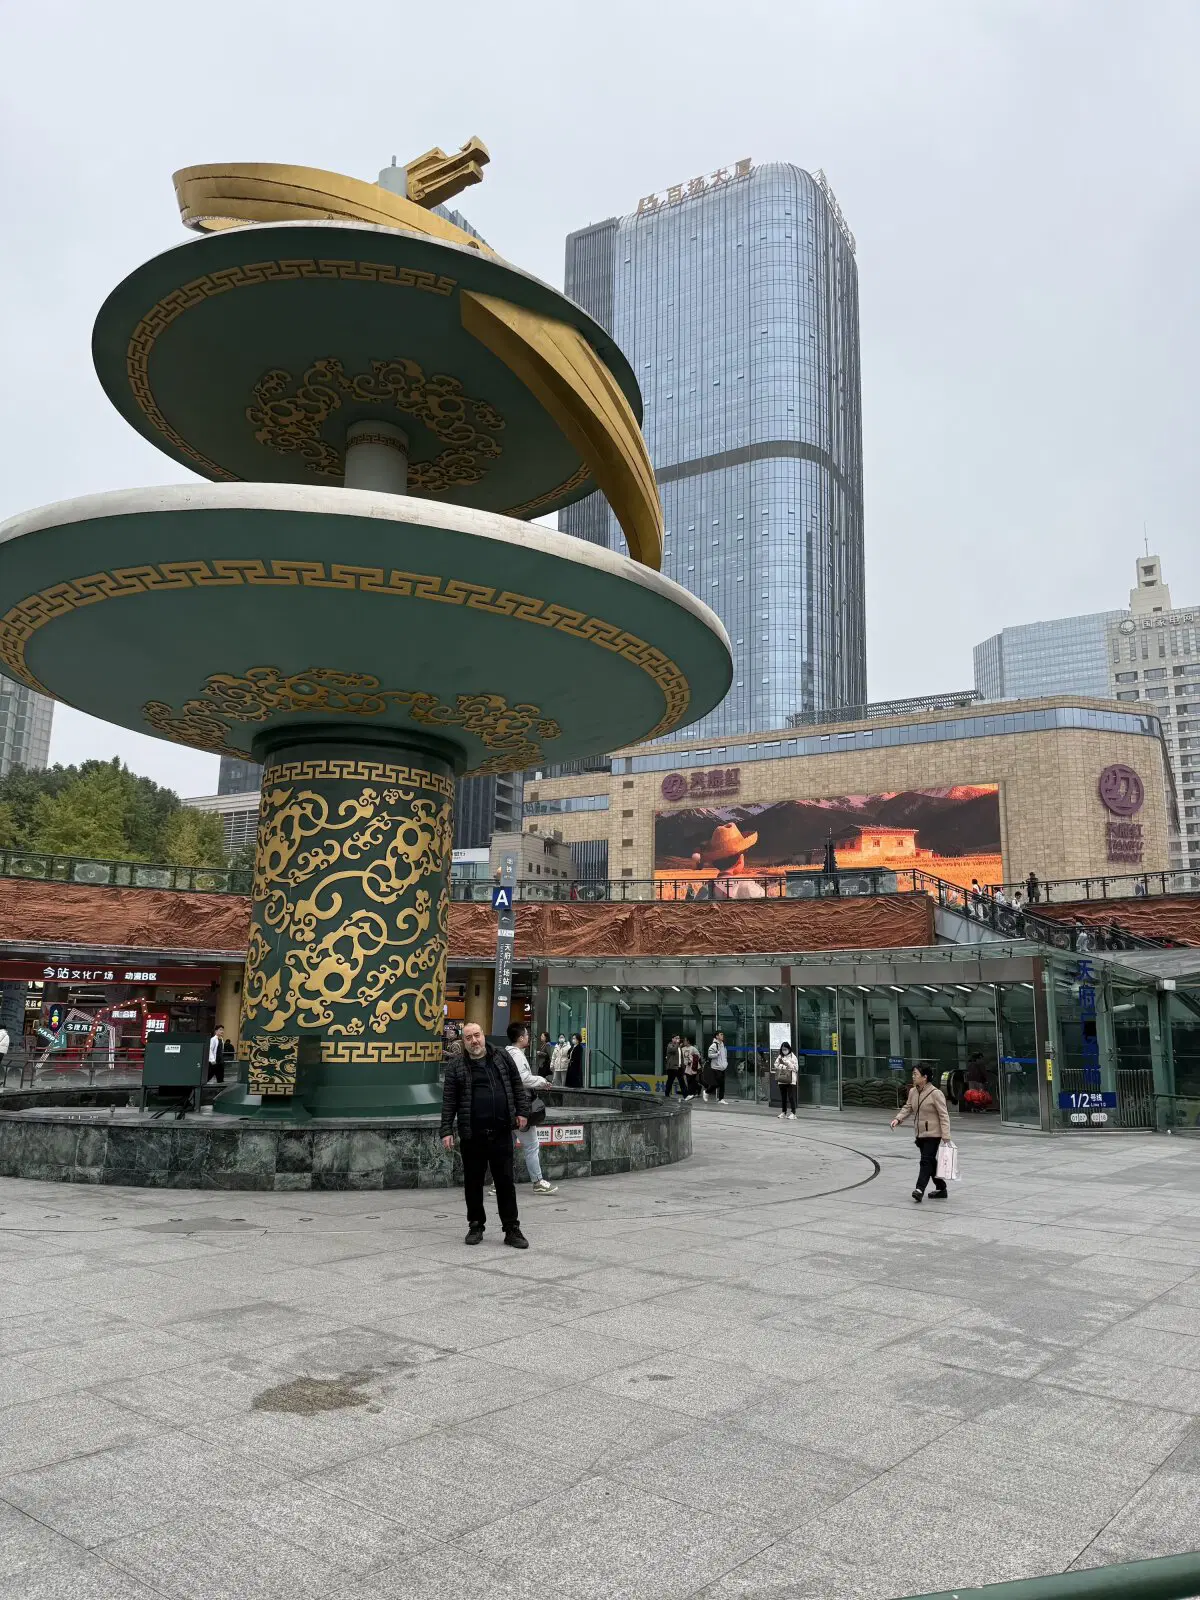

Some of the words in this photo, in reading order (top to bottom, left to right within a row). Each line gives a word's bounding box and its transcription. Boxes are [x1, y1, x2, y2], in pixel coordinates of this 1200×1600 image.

[1142, 613, 1194, 630] 国家电网
[495, 889, 509, 906] A
[43, 966, 114, 980] 今站文化广场
[502, 943, 512, 986] 天府广场站
[1070, 1093, 1090, 1108] 1/2
